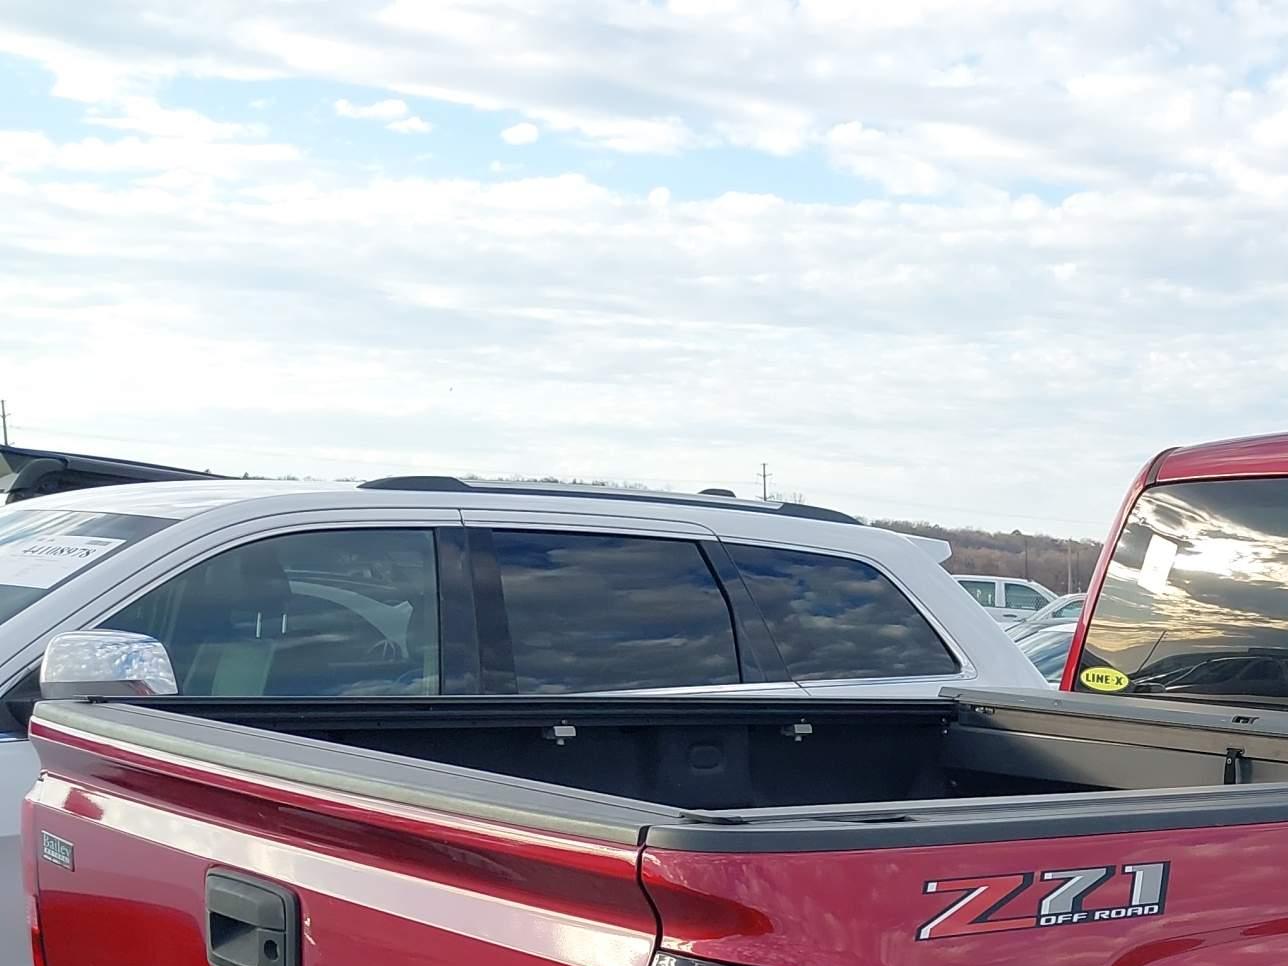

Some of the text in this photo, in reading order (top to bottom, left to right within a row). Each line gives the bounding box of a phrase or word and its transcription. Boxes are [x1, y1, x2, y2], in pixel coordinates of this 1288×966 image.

[914, 860, 1171, 942] Z71
[1039, 903, 1160, 927] OFF ROAD
